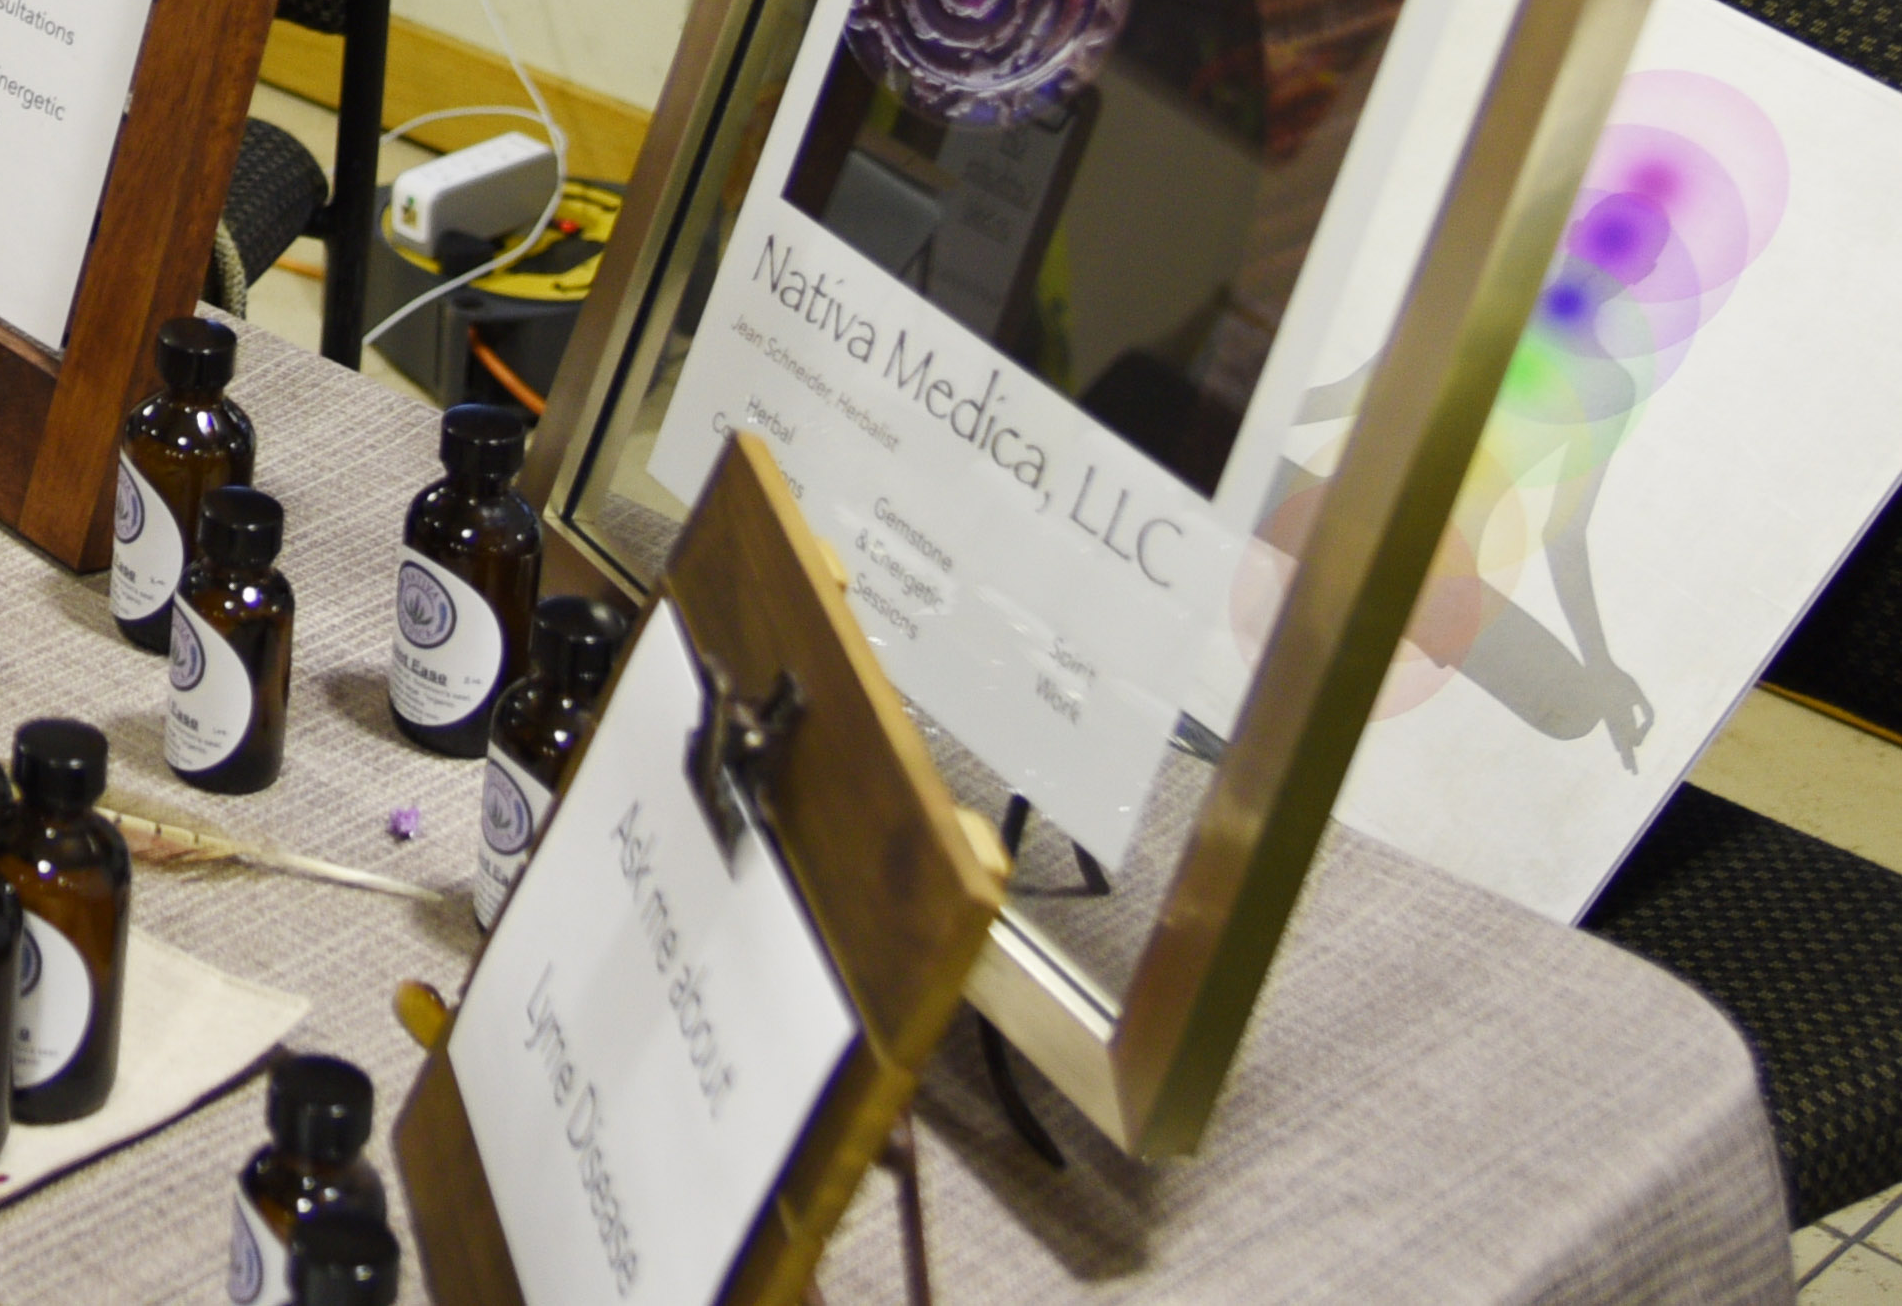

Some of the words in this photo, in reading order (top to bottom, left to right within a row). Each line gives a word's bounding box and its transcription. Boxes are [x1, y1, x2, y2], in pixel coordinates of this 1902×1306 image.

[731, 313, 764, 351] Jean
[763, 336, 835, 410] Schneider,
[835, 392, 900, 453] Herbalist
[745, 394, 795, 446] Herbal
[752, 233, 877, 363] Nativa
[886, 327, 1050, 513] Medica,
[1068, 464, 1185, 589] LLC
[855, 527, 869, 553] &
[870, 541, 945, 613] Energetic
[873, 496, 954, 575] Gemstone
[853, 572, 921, 641] Sessions
[411, 657, 448, 687] Ease
[1049, 635, 1097, 681] Spirit
[1034, 673, 1083, 727] Work
[611, 800, 656, 900] Ask
[638, 890, 677, 974] me
[667, 960, 737, 1121] about
[522, 961, 577, 1108] Lyme
[565, 1082, 641, 1298] Disease
